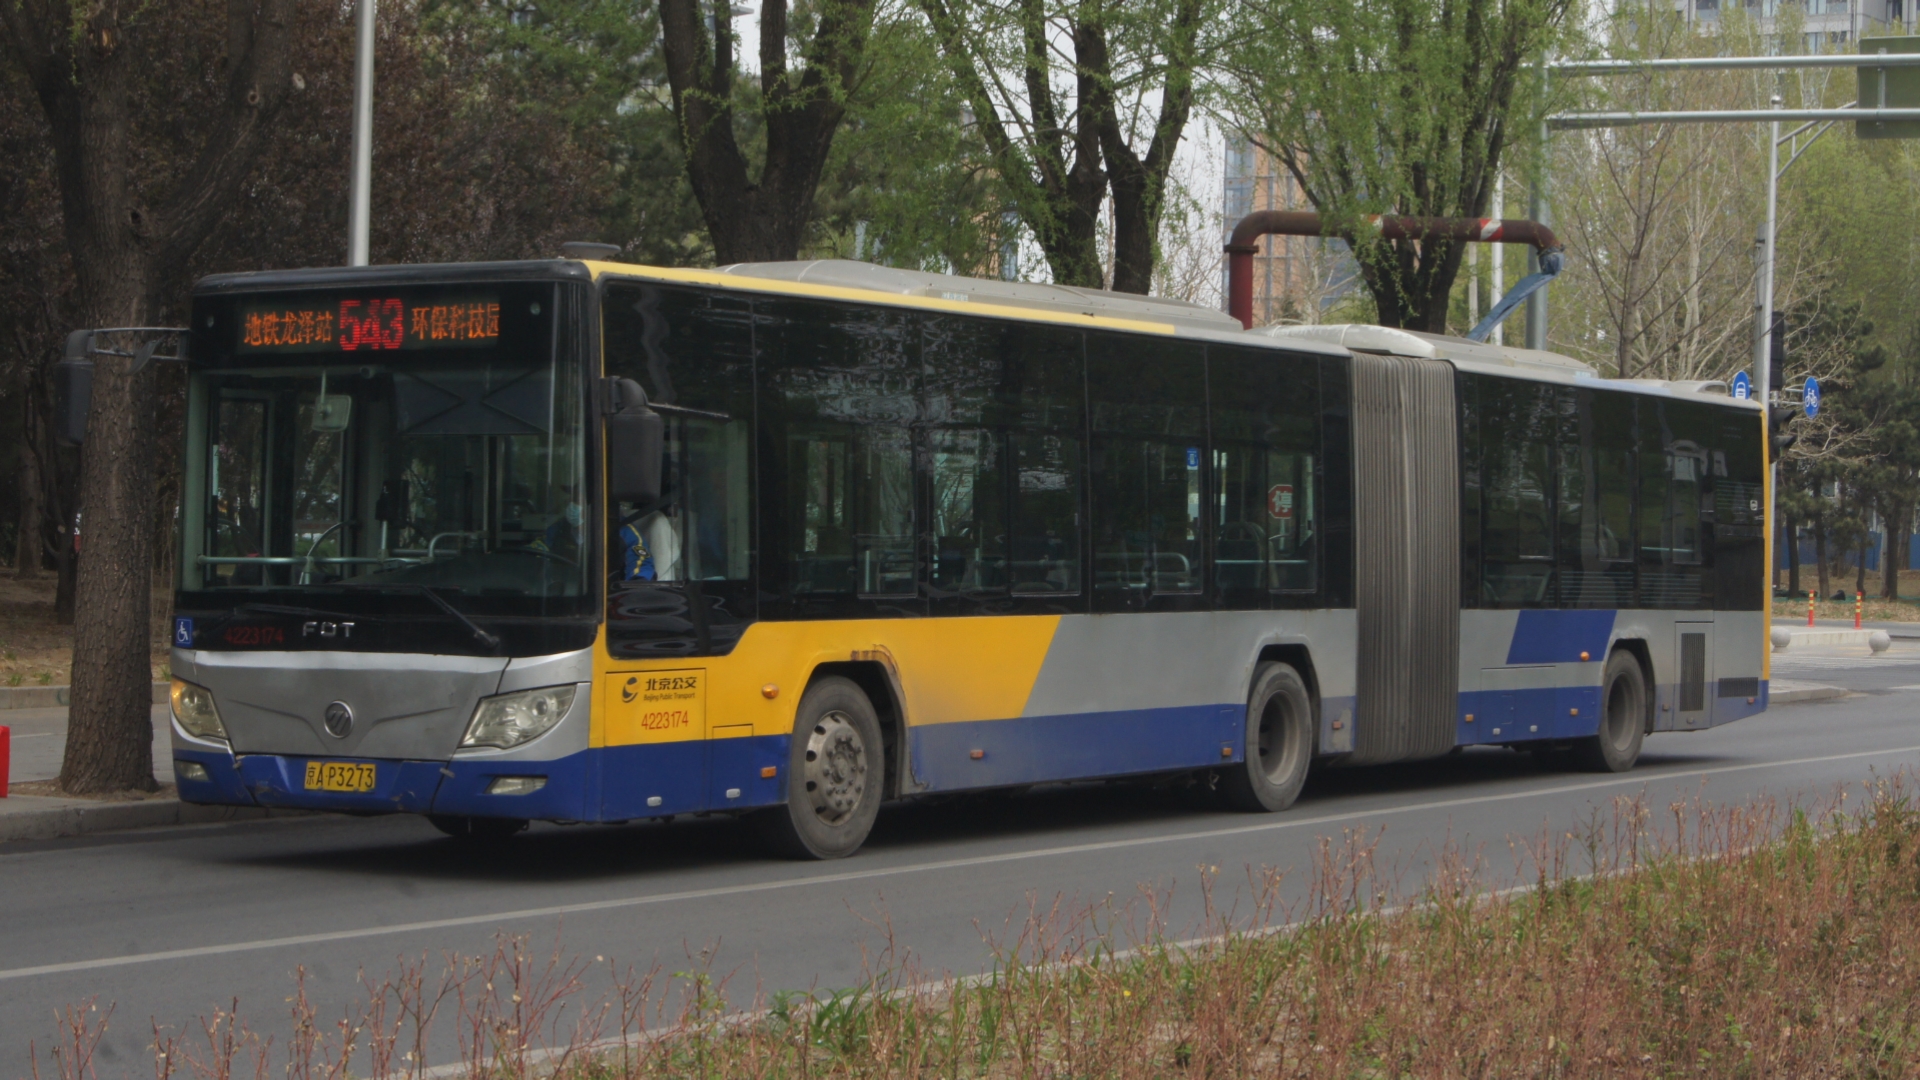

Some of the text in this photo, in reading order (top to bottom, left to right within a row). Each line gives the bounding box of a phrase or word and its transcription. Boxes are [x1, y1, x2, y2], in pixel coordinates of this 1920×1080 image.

[243, 310, 333, 347] 地铁龙泽站
[339, 298, 404, 351] 543
[1271, 490, 1293, 513] 停
[223, 626, 285, 645] 4223174
[645, 676, 698, 692] 北京公交
[643, 692, 696, 702] Beijing Public Transport
[641, 710, 689, 731] 4223174
